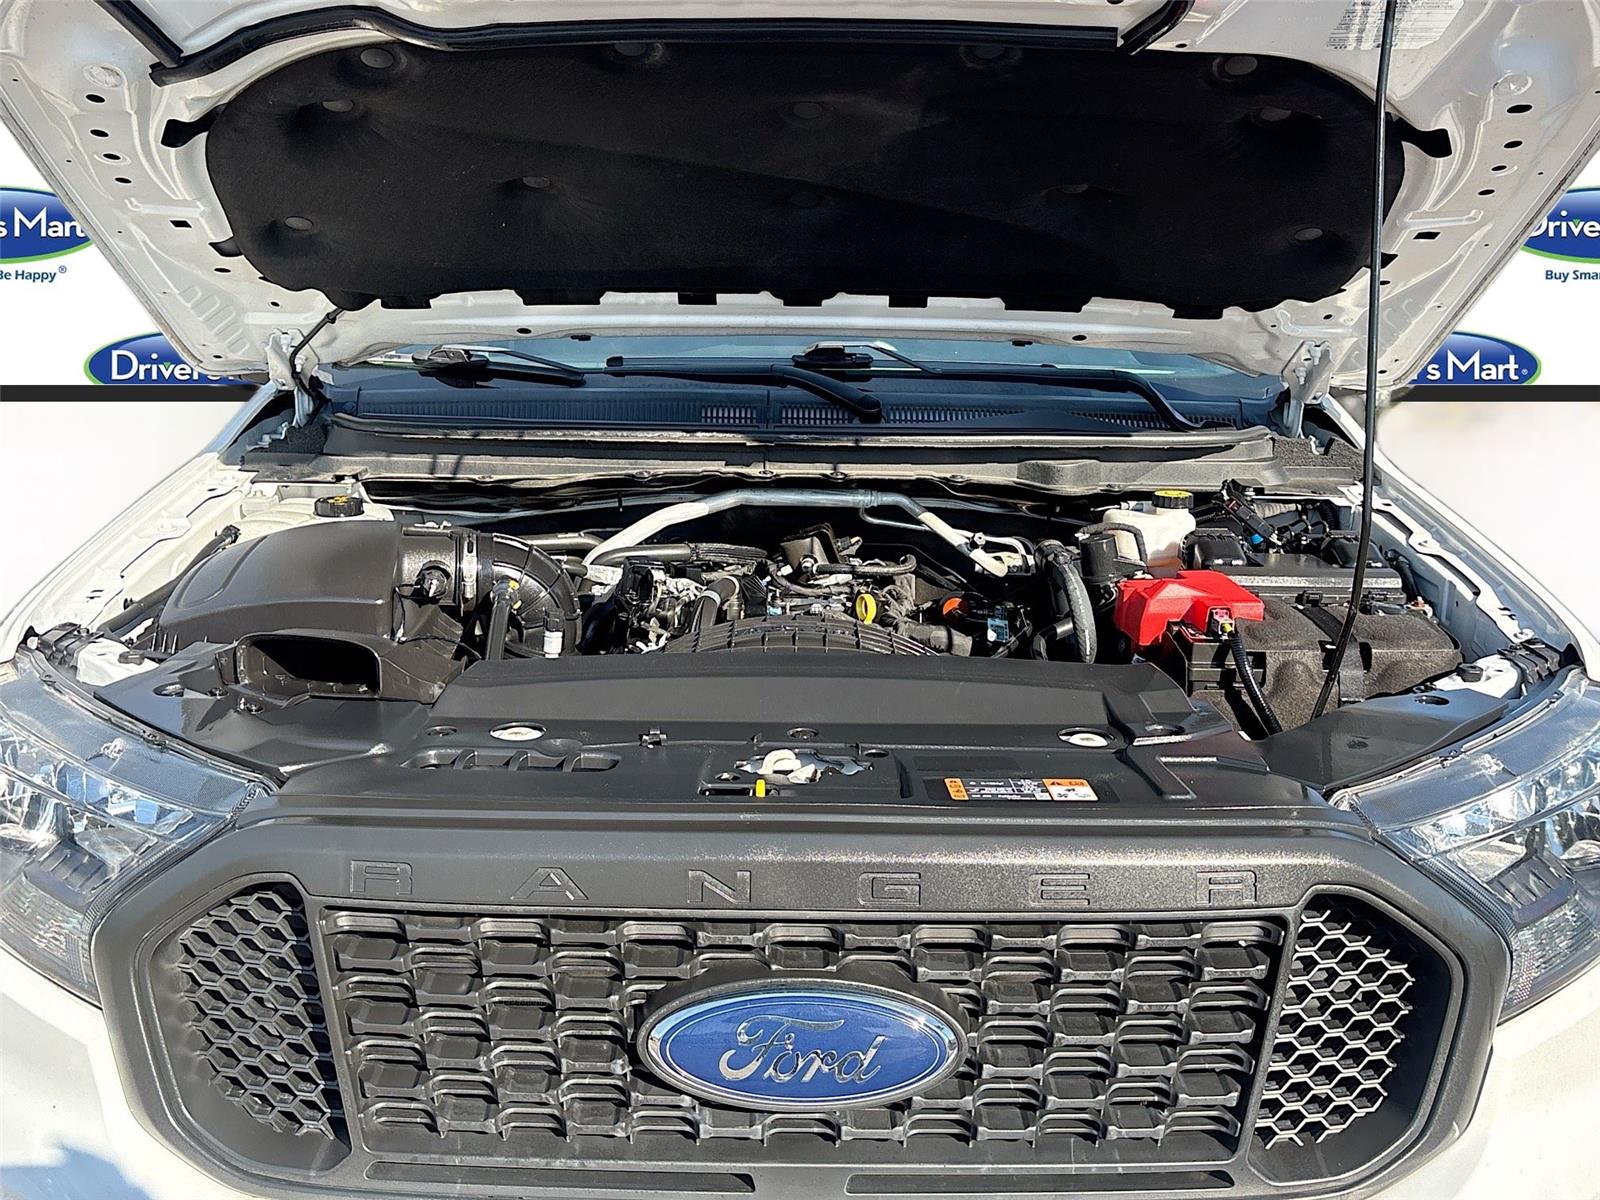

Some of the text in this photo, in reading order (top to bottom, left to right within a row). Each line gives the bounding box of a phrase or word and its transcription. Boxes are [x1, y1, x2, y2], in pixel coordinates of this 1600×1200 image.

[15, 270, 56, 283] Happy
[1545, 270, 1600, 283] Buy Sma
[1447, 349, 1519, 380] Mart
[350, 859, 1258, 906] RANGER
[719, 1014, 889, 1083] Ford
